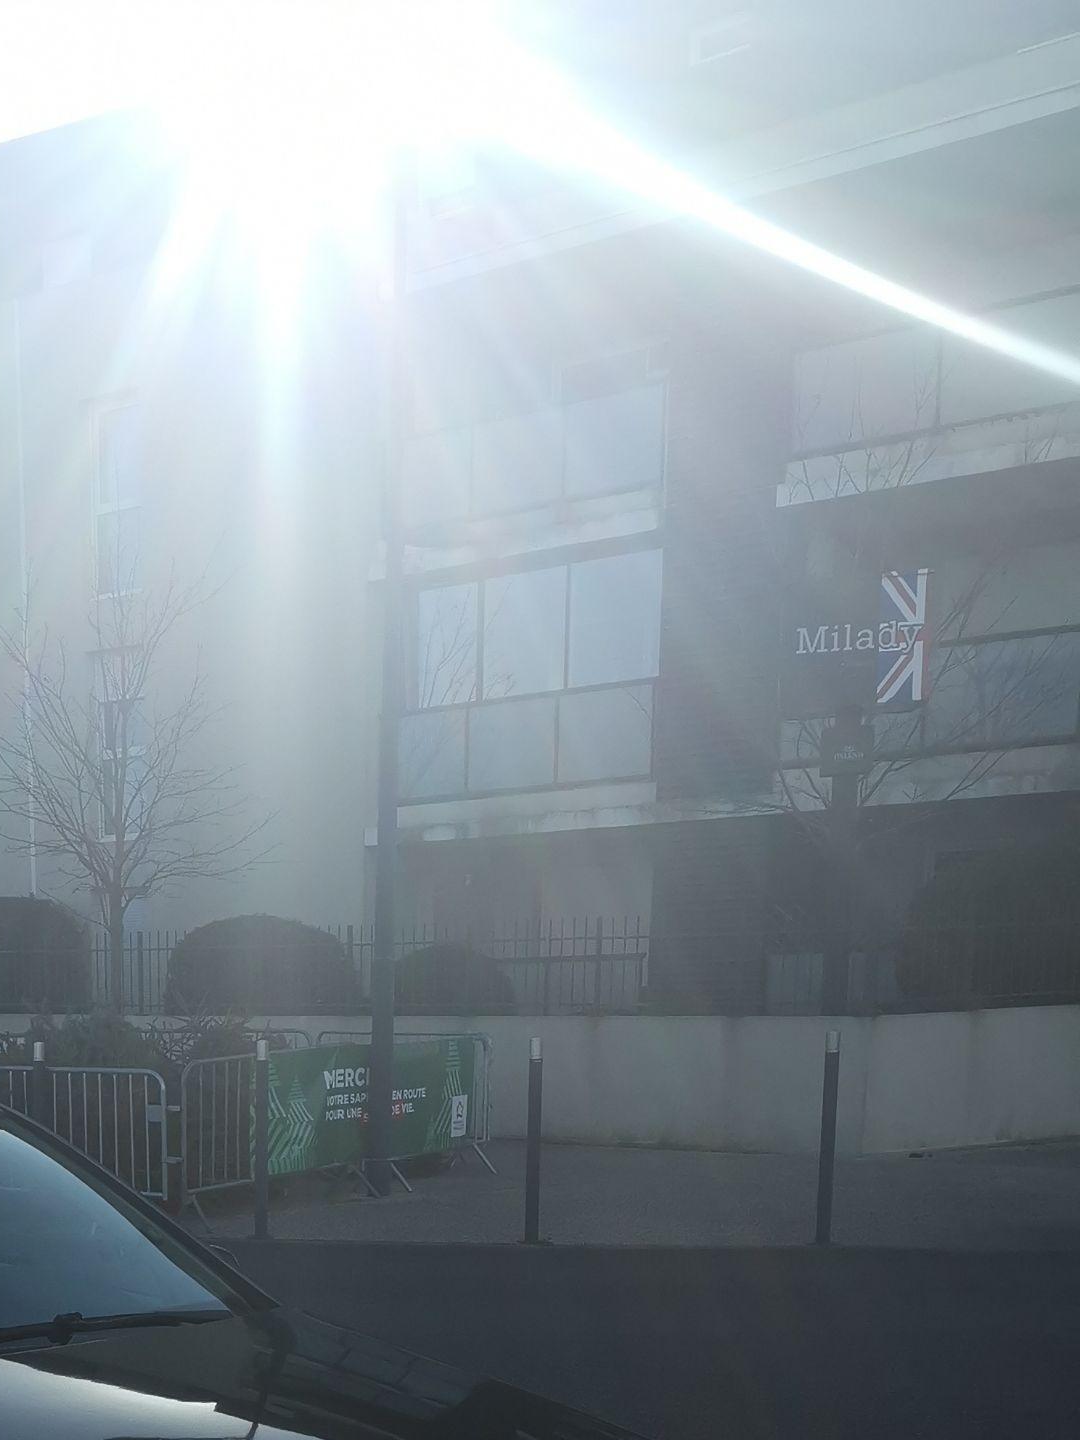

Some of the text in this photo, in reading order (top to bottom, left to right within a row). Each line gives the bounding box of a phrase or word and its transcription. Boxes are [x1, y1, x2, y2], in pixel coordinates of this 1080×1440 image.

[795, 620, 923, 653] Milady
[403, 1087, 426, 1100] ROUTE
[325, 1109, 345, 1121] POUR
[346, 1108, 363, 1119] UNE
